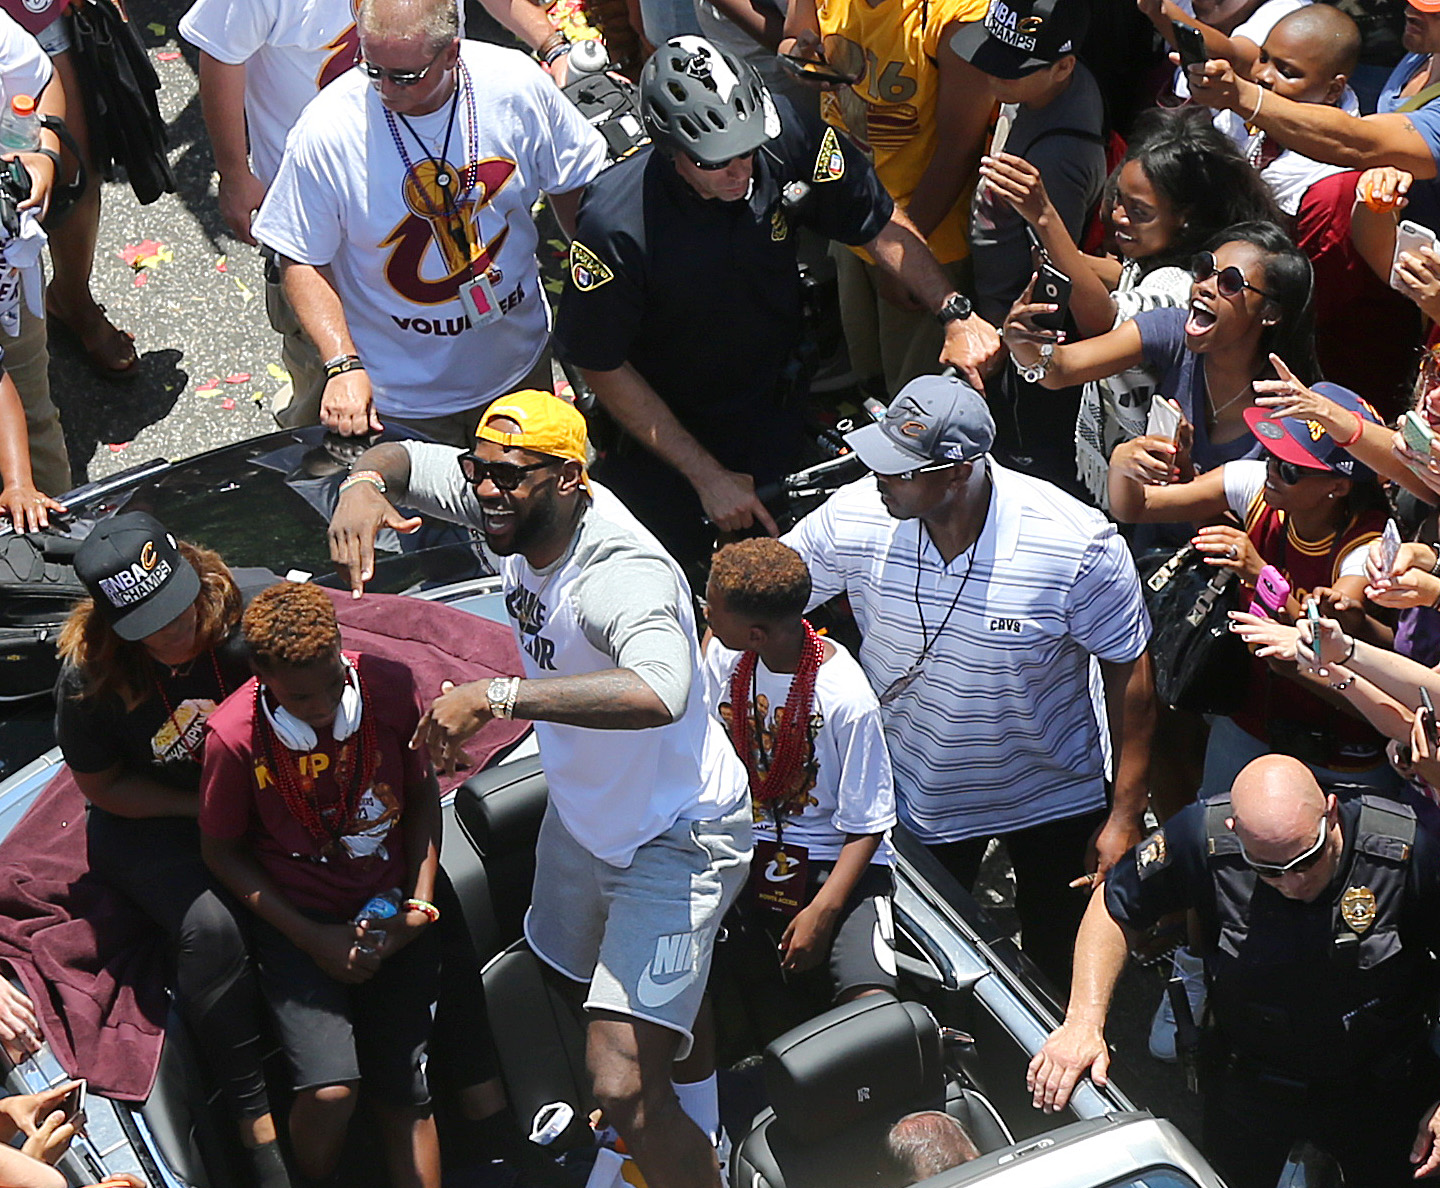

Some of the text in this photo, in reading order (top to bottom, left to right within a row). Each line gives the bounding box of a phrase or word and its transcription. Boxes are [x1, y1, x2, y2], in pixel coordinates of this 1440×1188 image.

[111, 563, 148, 594] NBA
[120, 560, 172, 604] CHAMPS
[990, 617, 1021, 634] CAVS
